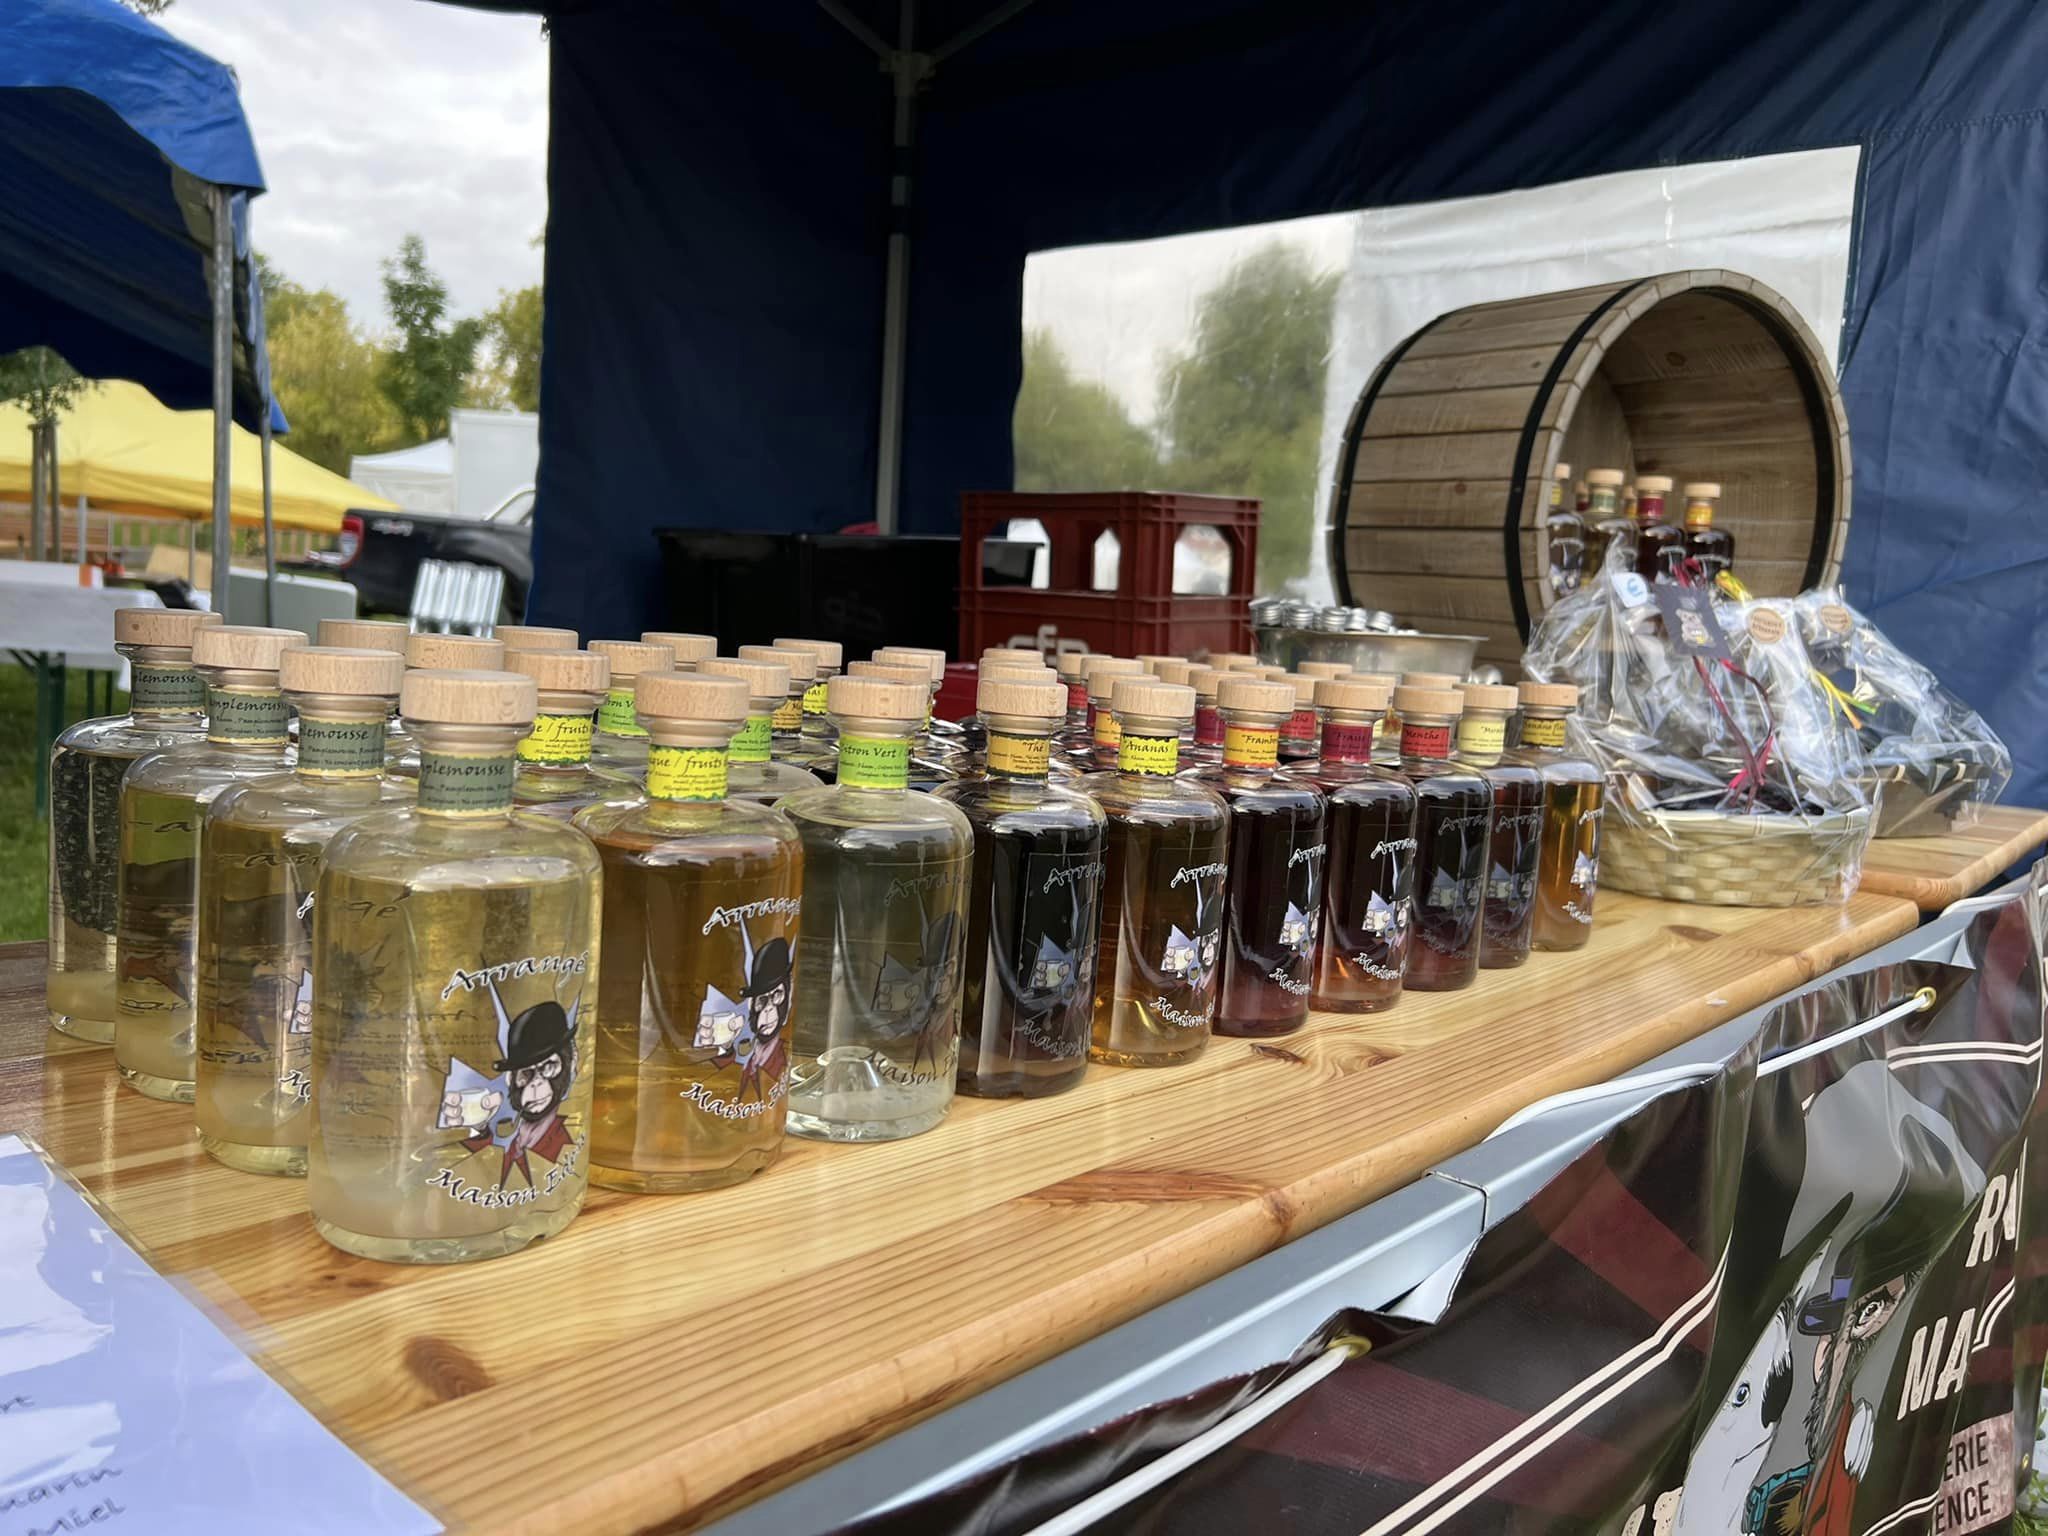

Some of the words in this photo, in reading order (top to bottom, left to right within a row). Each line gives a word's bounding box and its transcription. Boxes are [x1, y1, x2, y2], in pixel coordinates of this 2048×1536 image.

[873, 747, 897, 758] Vert
[441, 951, 589, 999] Arrangé
[680, 1081, 766, 1119] Maison
[426, 1167, 539, 1209] Maison
